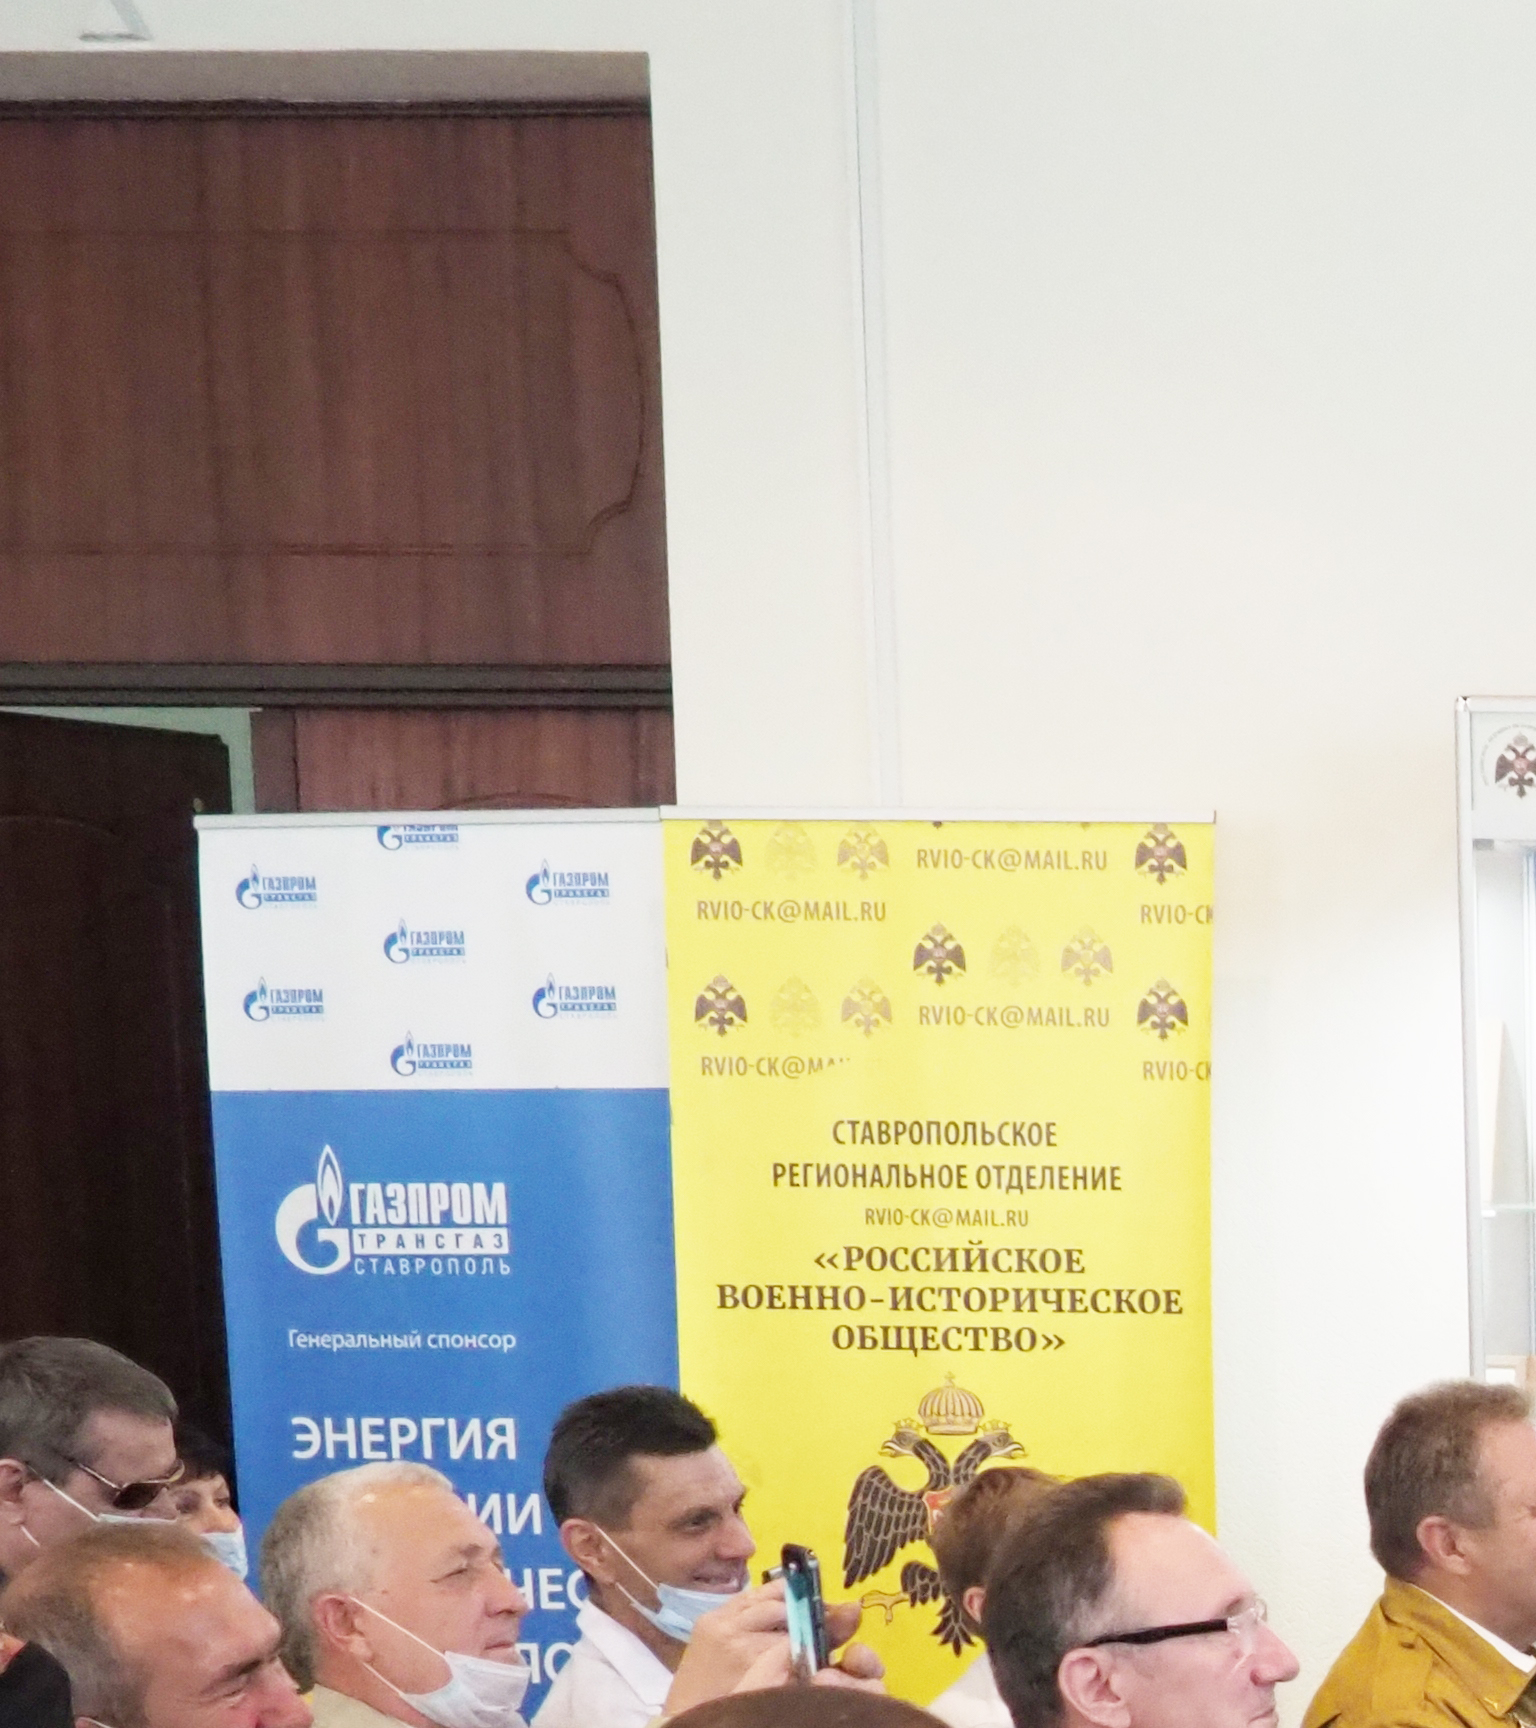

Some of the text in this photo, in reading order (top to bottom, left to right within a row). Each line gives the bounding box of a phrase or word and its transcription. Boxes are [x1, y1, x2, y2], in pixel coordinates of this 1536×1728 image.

[916, 849, 1107, 872] RVIO-CK@MAIL.RU
[262, 876, 316, 891] ГАЗПРОМ
[552, 872, 609, 887] ГАЗПРОМ
[696, 900, 887, 923] RVIO-CK@MAIL.RU
[410, 931, 465, 945] ГАЗПРОМ
[270, 989, 323, 1003] ГАЗПРОМ
[559, 986, 616, 1000] ГАЗПРОМ
[919, 1005, 1110, 1028] RVIO-CK@MAIL.RU
[417, 1043, 472, 1058] ГАЗПРОМ
[832, 1119, 1058, 1148] СТАВРОПОЛЬСКОЕ
[772, 1162, 1122, 1194] РЕГИОНАЛЬНОЕ ОТДЕЛЕНИЕ
[350, 1182, 508, 1225] ГАЗПРОМ
[864, 1207, 1029, 1228] RVIO-CK@MAIL.RU
[357, 1231, 505, 1251] ТРАНСГАЗ
[353, 1256, 511, 1276] СТАВРОПОЛЬ
[813, 1240, 1085, 1274] «РОССИЙСКОЕ
[717, 1283, 1183, 1315] ВОЕННО-ИСТОРИЧЕСКОЕ
[288, 1329, 516, 1352] Генеральный спонсор
[832, 1324, 1066, 1356] ОБЩЕСТВО»
[292, 1417, 517, 1460] ЭНЕРГИЯ
